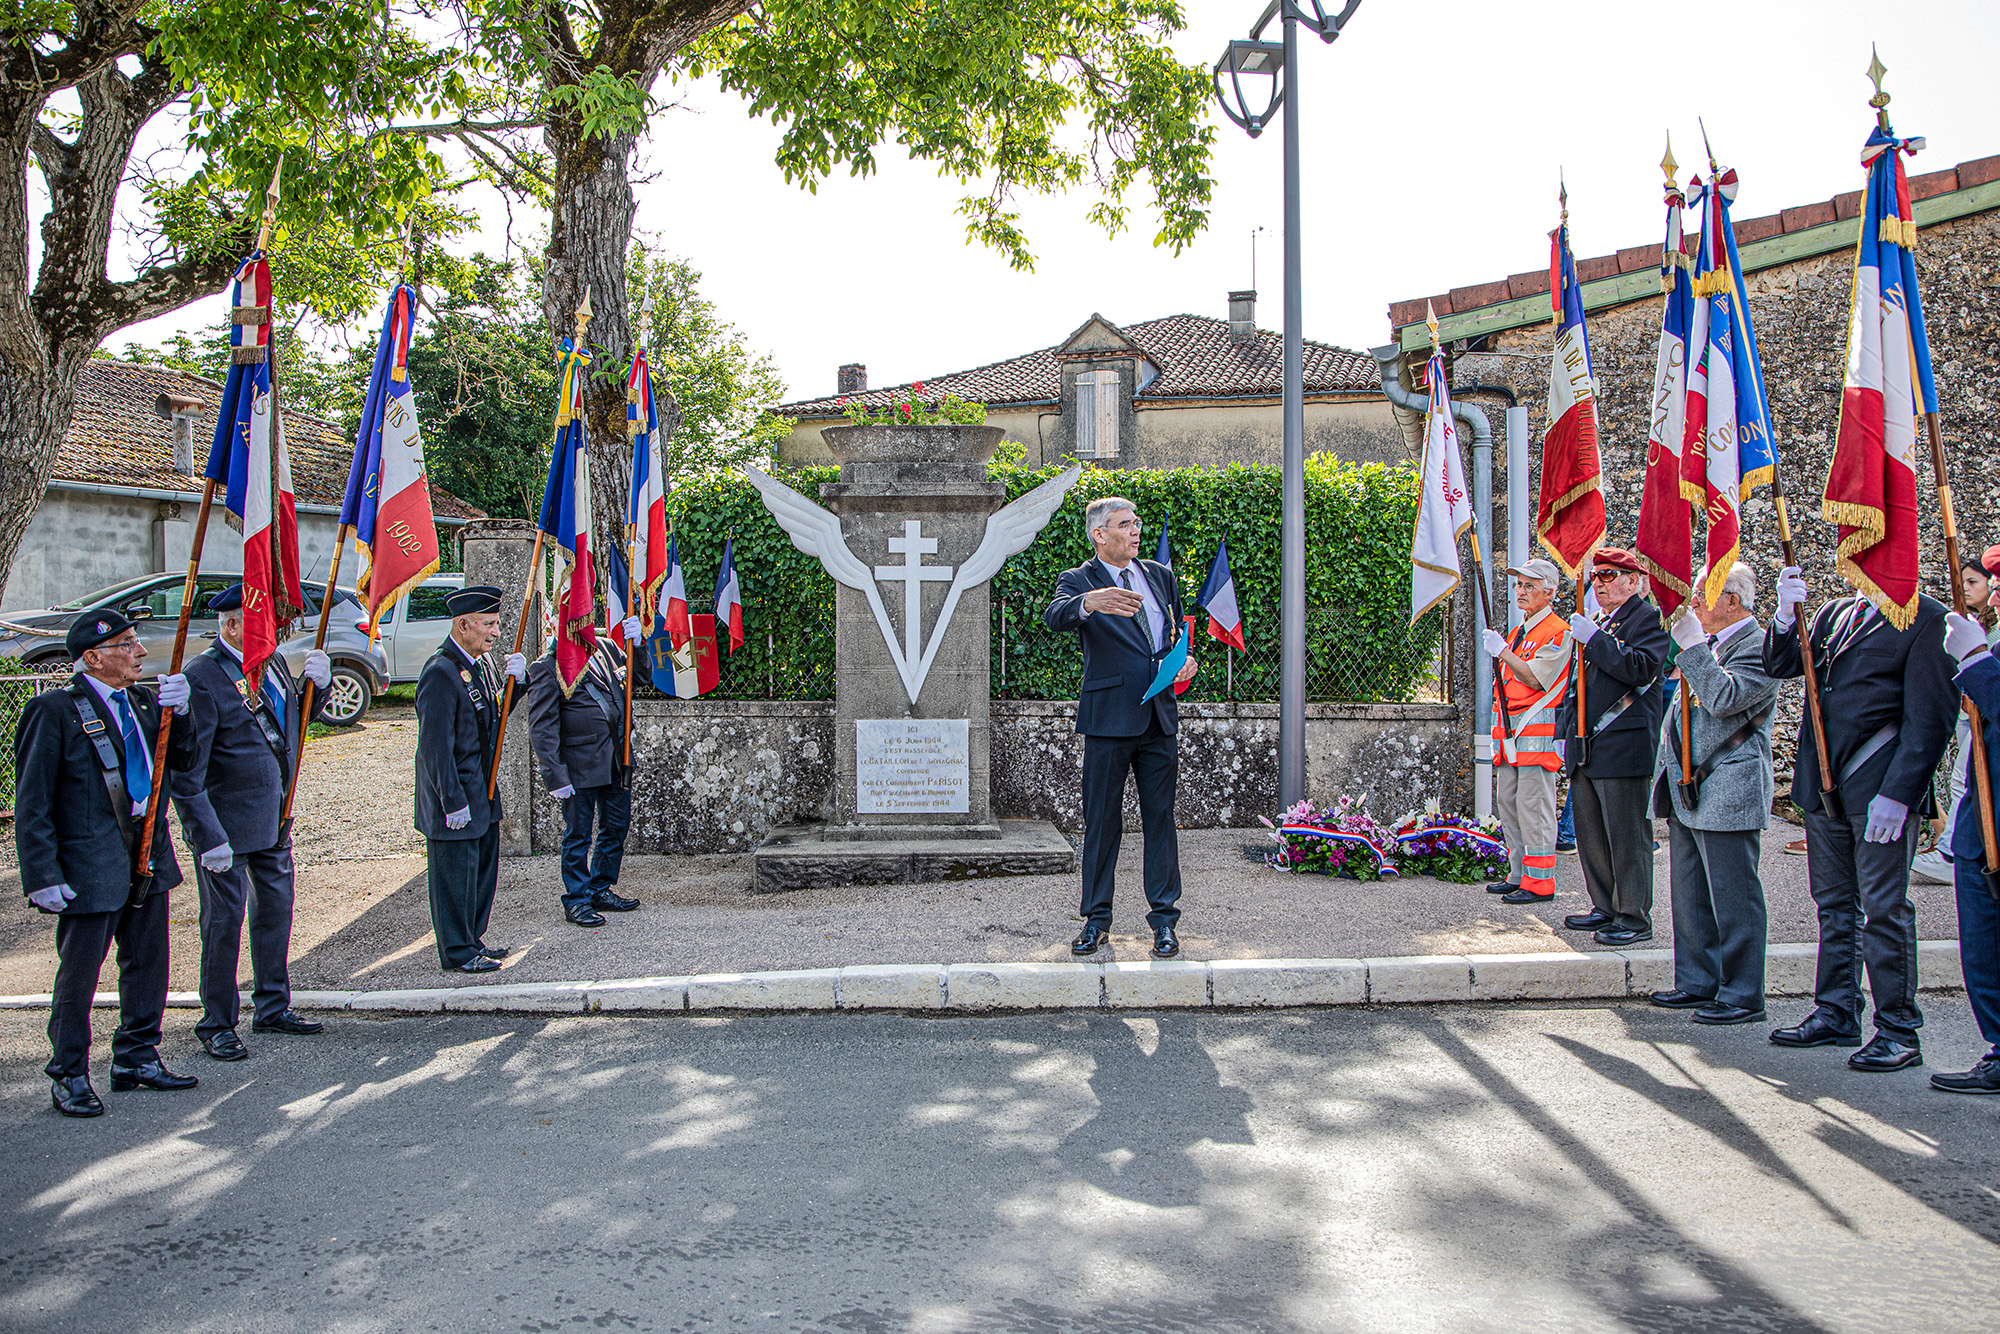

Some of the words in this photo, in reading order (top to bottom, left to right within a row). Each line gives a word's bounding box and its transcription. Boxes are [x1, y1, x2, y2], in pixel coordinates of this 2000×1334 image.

[1563, 346, 1585, 373] DE
[384, 519, 423, 558] 1962
[652, 634, 716, 675] RF
[896, 737, 902, 745] 6
[869, 757, 910, 765] BATAILLON
[927, 777, 963, 786] PARISOT
